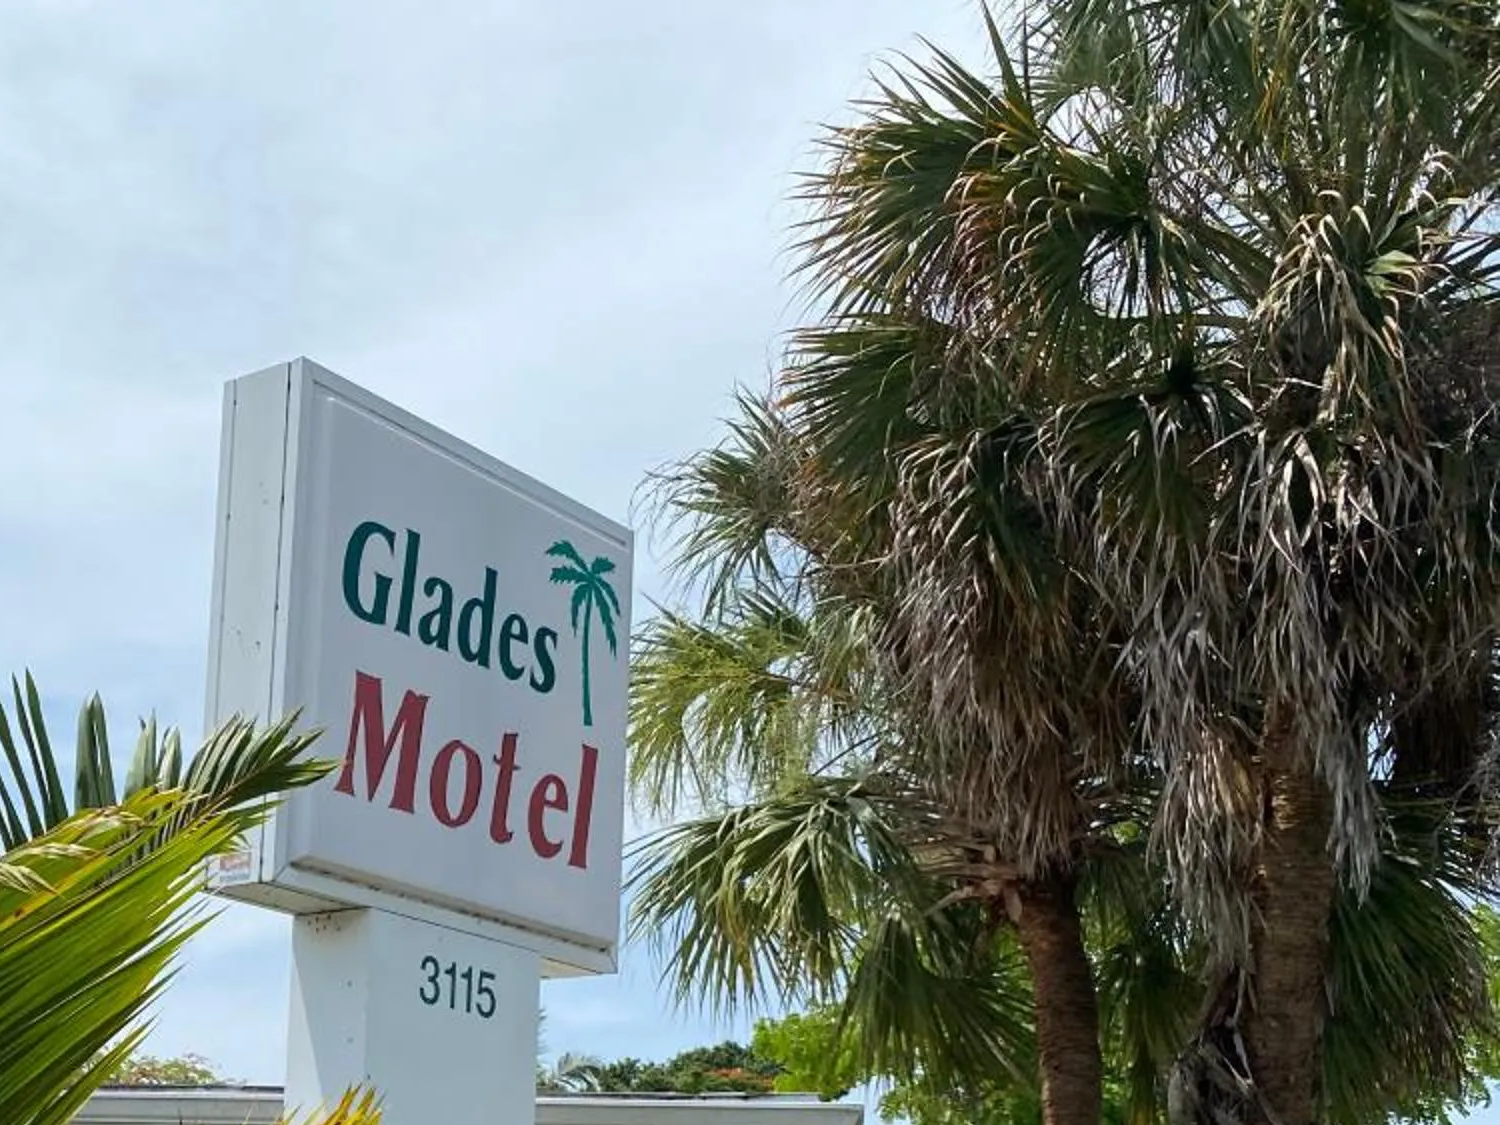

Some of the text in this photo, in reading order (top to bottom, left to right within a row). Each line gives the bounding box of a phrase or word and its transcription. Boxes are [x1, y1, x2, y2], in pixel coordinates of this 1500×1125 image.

[342, 520, 557, 693] Glades
[334, 670, 598, 869] Motel
[419, 955, 497, 1019] 3115
